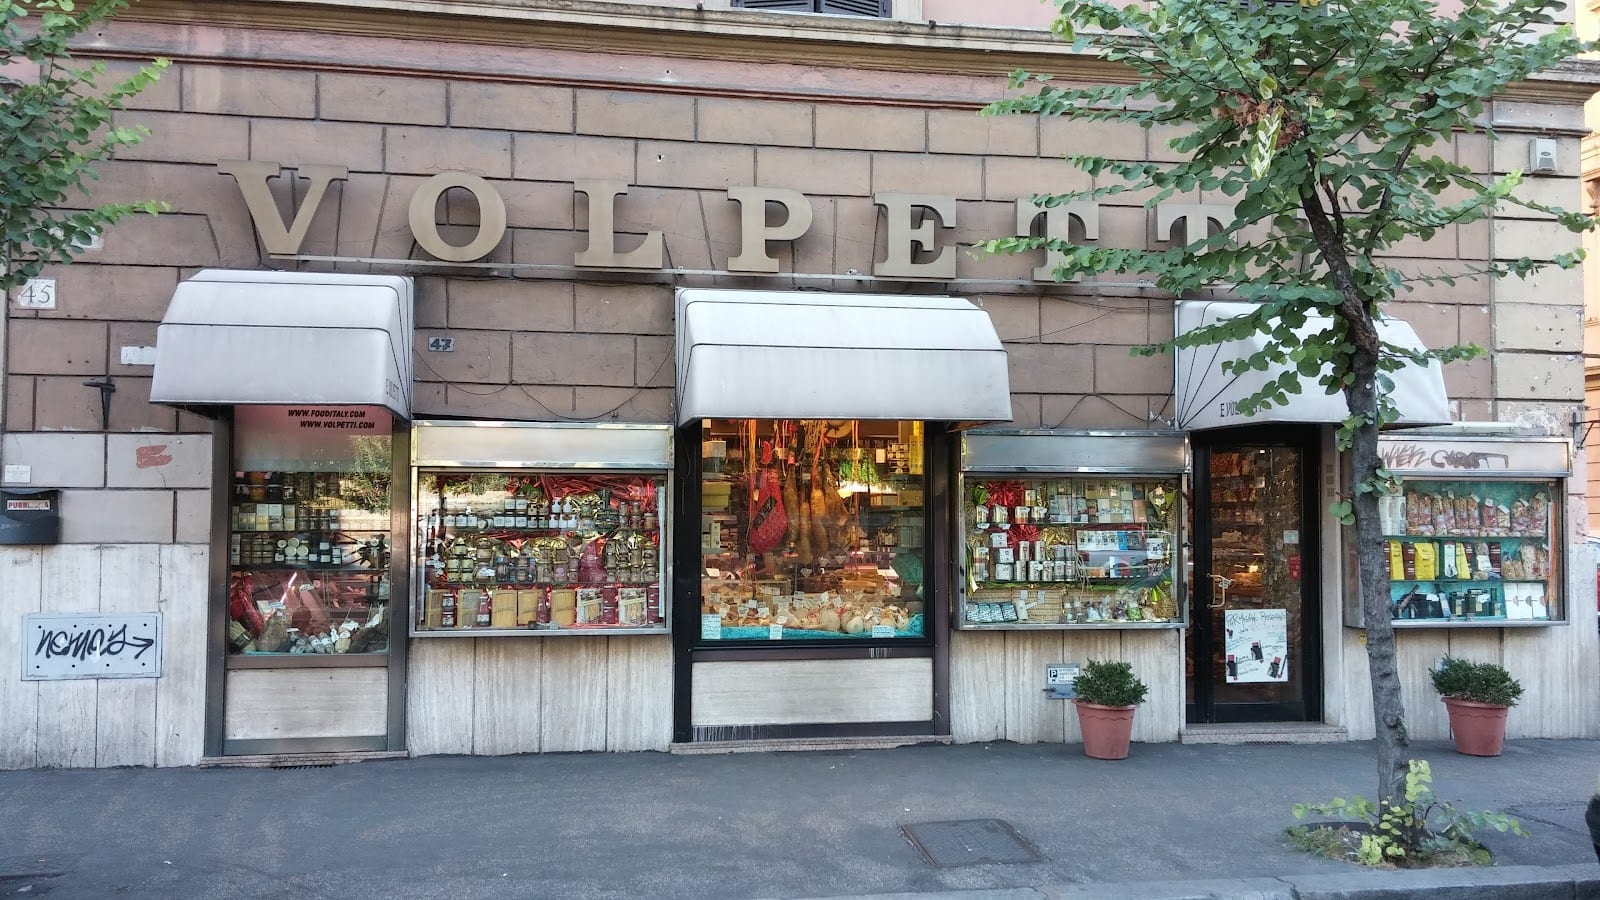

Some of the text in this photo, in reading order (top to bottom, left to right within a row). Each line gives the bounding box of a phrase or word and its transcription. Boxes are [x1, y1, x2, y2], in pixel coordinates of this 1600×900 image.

[20, 284, 53, 304] 45
[430, 338, 452, 350] 47
[288, 409, 366, 418] WWW.FOODITALY.COM
[300, 420, 375, 429] WWW.VOLPETTI.COM
